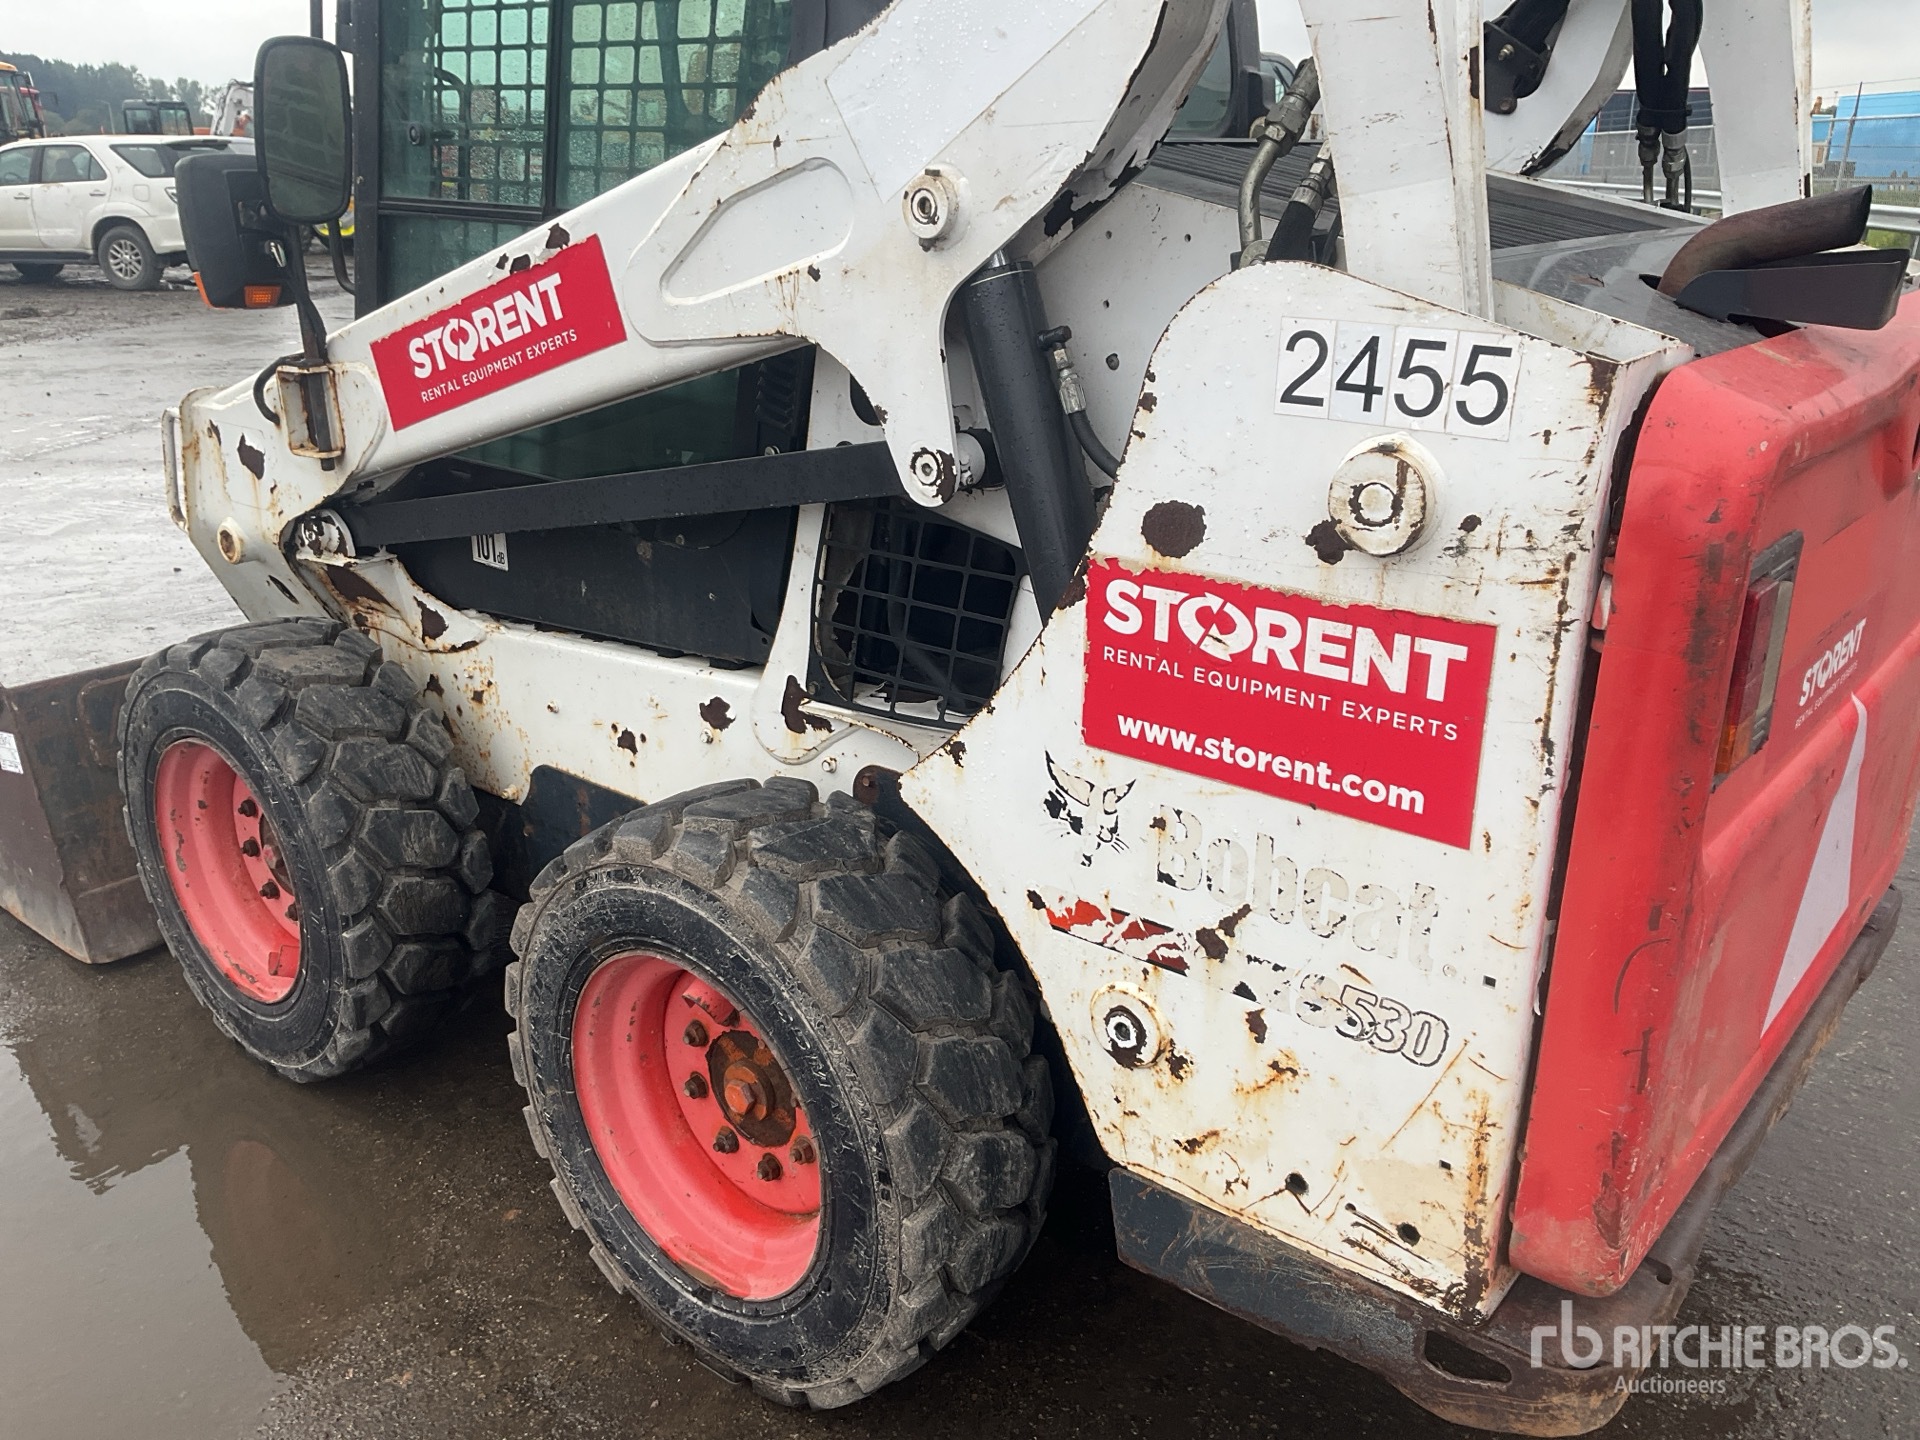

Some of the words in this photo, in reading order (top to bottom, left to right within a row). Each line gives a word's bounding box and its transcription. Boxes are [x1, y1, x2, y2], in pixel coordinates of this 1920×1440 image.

[409, 273, 564, 379] STORENT
[421, 379, 461, 403] RENTAL
[462, 351, 523, 387] EQUIPMENT
[527, 329, 578, 360] EXPERTS
[1280, 330, 1513, 426] 2455
[1103, 579, 1468, 702] STORENT
[1799, 617, 1867, 707] STORENT
[1103, 646, 1185, 680] RENTAL
[1193, 667, 1331, 712] EQUIPMENT
[1341, 701, 1459, 742] EXPERTS
[1117, 714, 1425, 815] www.storent.com
